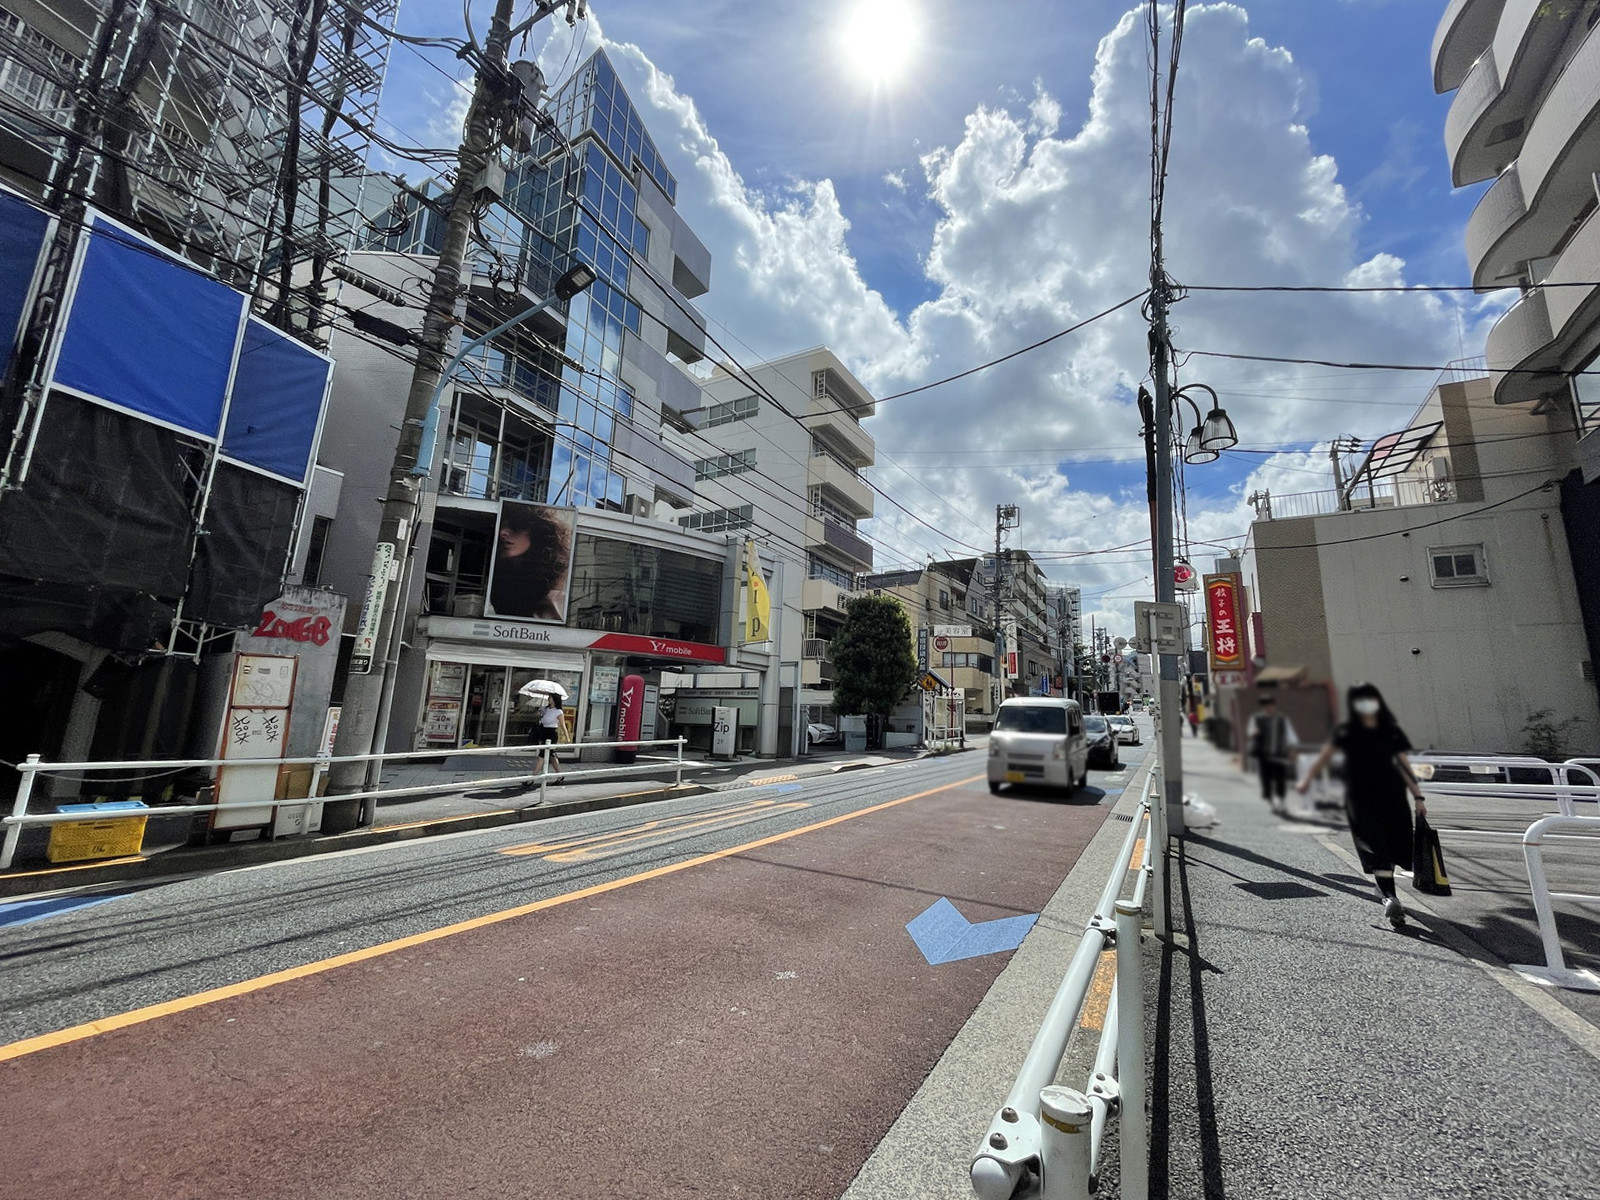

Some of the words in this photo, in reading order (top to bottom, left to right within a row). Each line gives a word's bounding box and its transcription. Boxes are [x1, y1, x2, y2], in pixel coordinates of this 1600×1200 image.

[1215, 587, 1236, 654] 餃子の王将
[493, 625, 550, 642] SoftBank
[713, 721, 730, 734] Zip
